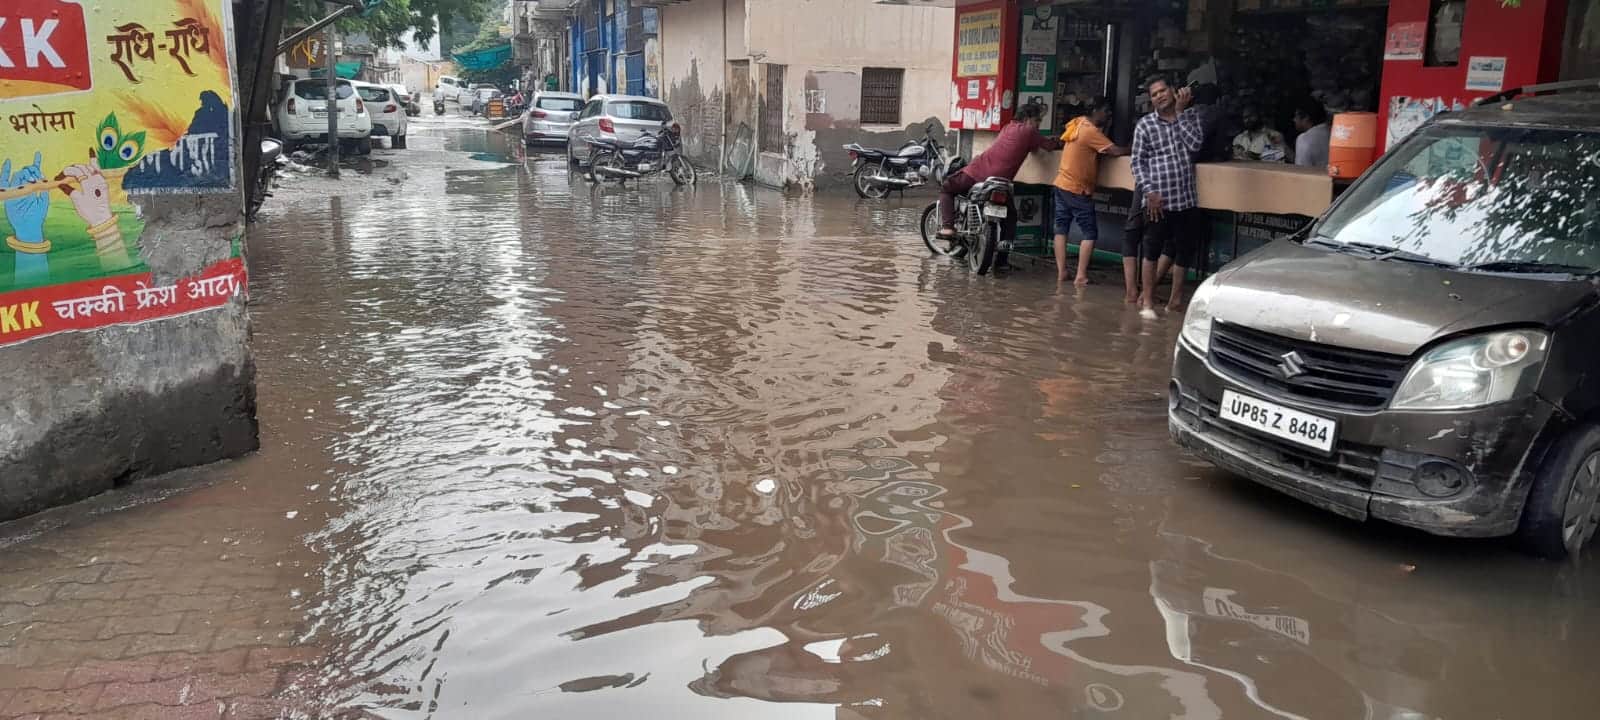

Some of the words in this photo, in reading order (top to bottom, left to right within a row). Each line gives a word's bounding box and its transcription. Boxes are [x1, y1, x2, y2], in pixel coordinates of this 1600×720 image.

[9, 104, 75, 134] भरोसा
[0, 301, 42, 333] KK
[51, 285, 126, 319] चक्की
[133, 281, 178, 310] फ्रेश
[187, 274, 234, 299] आटा
[1231, 399, 1269, 426] UP85
[1271, 412, 1284, 430] Z
[1288, 417, 1328, 444] 8484
